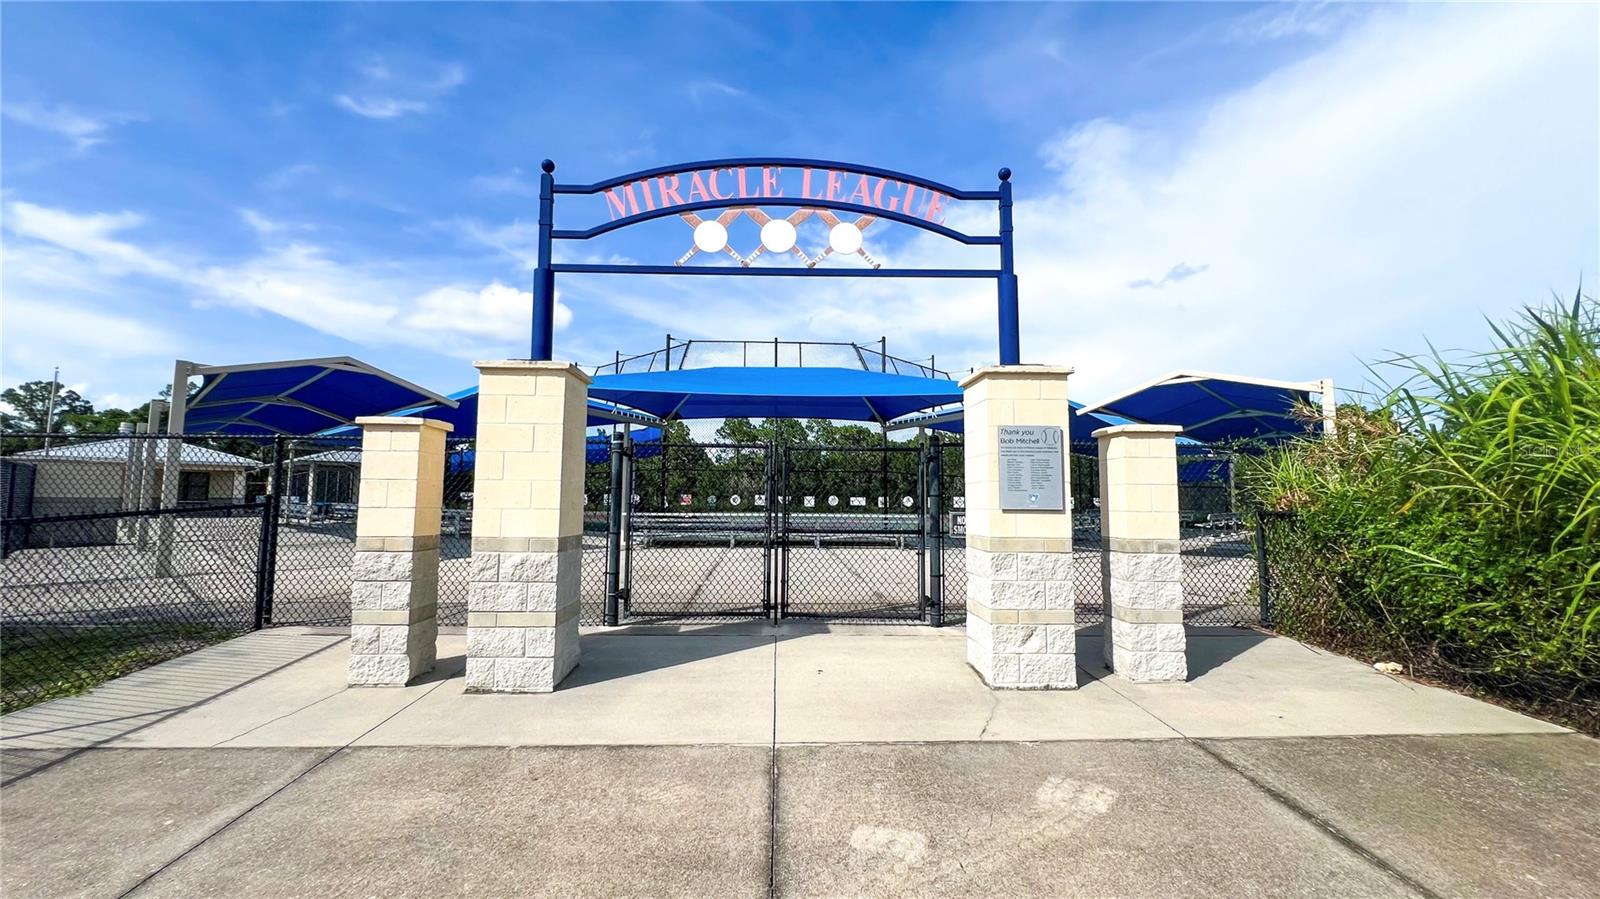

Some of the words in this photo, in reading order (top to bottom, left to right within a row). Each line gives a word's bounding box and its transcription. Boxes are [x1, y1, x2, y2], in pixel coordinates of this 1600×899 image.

[603, 165, 784, 221] MIRACLE
[802, 167, 951, 226] LEAGUE
[1000, 428, 1019, 436] Thank
